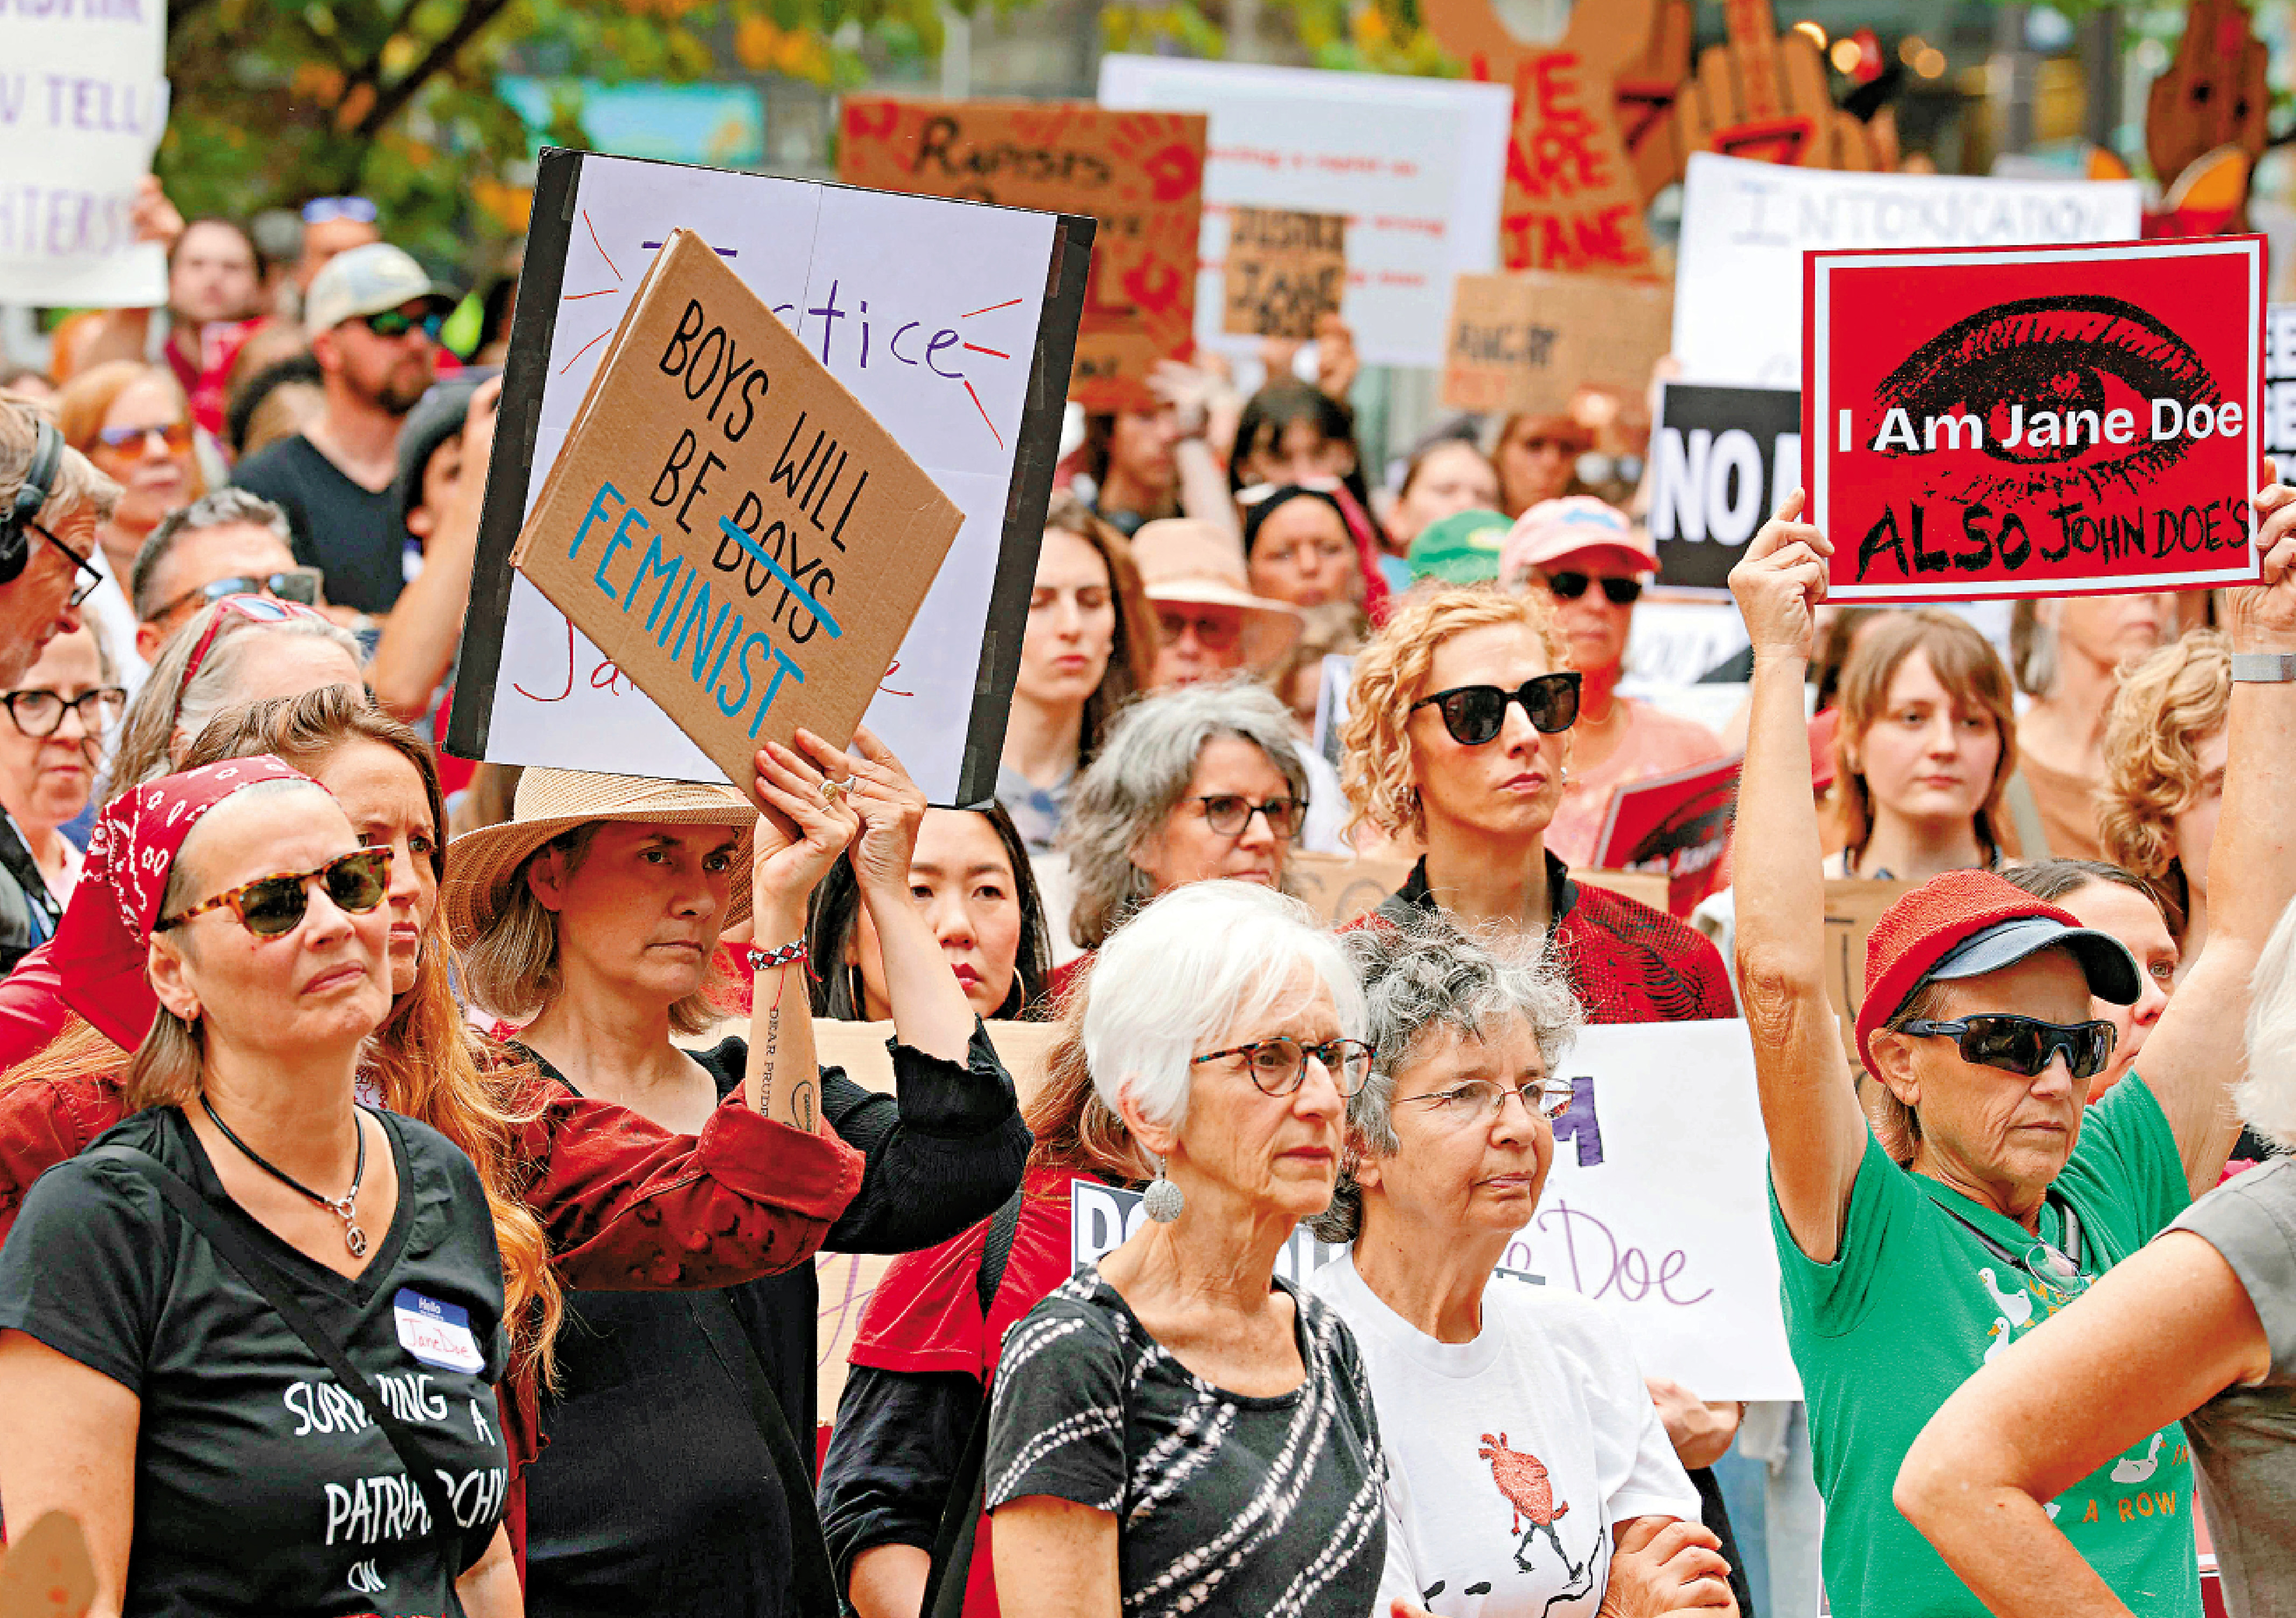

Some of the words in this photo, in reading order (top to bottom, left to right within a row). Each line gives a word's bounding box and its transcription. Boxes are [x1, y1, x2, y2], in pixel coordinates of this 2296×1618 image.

[659, 299, 769, 442] BOYS
[770, 412, 869, 553] WILL
[1839, 408, 1852, 452] I
[1873, 407, 1983, 451] Am
[2002, 404, 2134, 449] Jane
[2151, 398, 2243, 441] Doe
[1655, 428, 1763, 546] NO
[650, 429, 726, 534] BE
[711, 491, 835, 644] BOYS
[1855, 497, 2032, 582] ALSO
[2039, 501, 2145, 565] JOHN
[2152, 496, 2250, 559] DOE'S
[569, 482, 804, 740] FEMINIST
[513, 618, 636, 702] Ja
[1538, 1199, 1714, 1305] Doe
[284, 1374, 448, 1436] SURVVING
[470, 1399, 496, 1446] A
[2082, 1499, 2099, 1523] A
[2118, 1490, 2176, 1523] ROW
